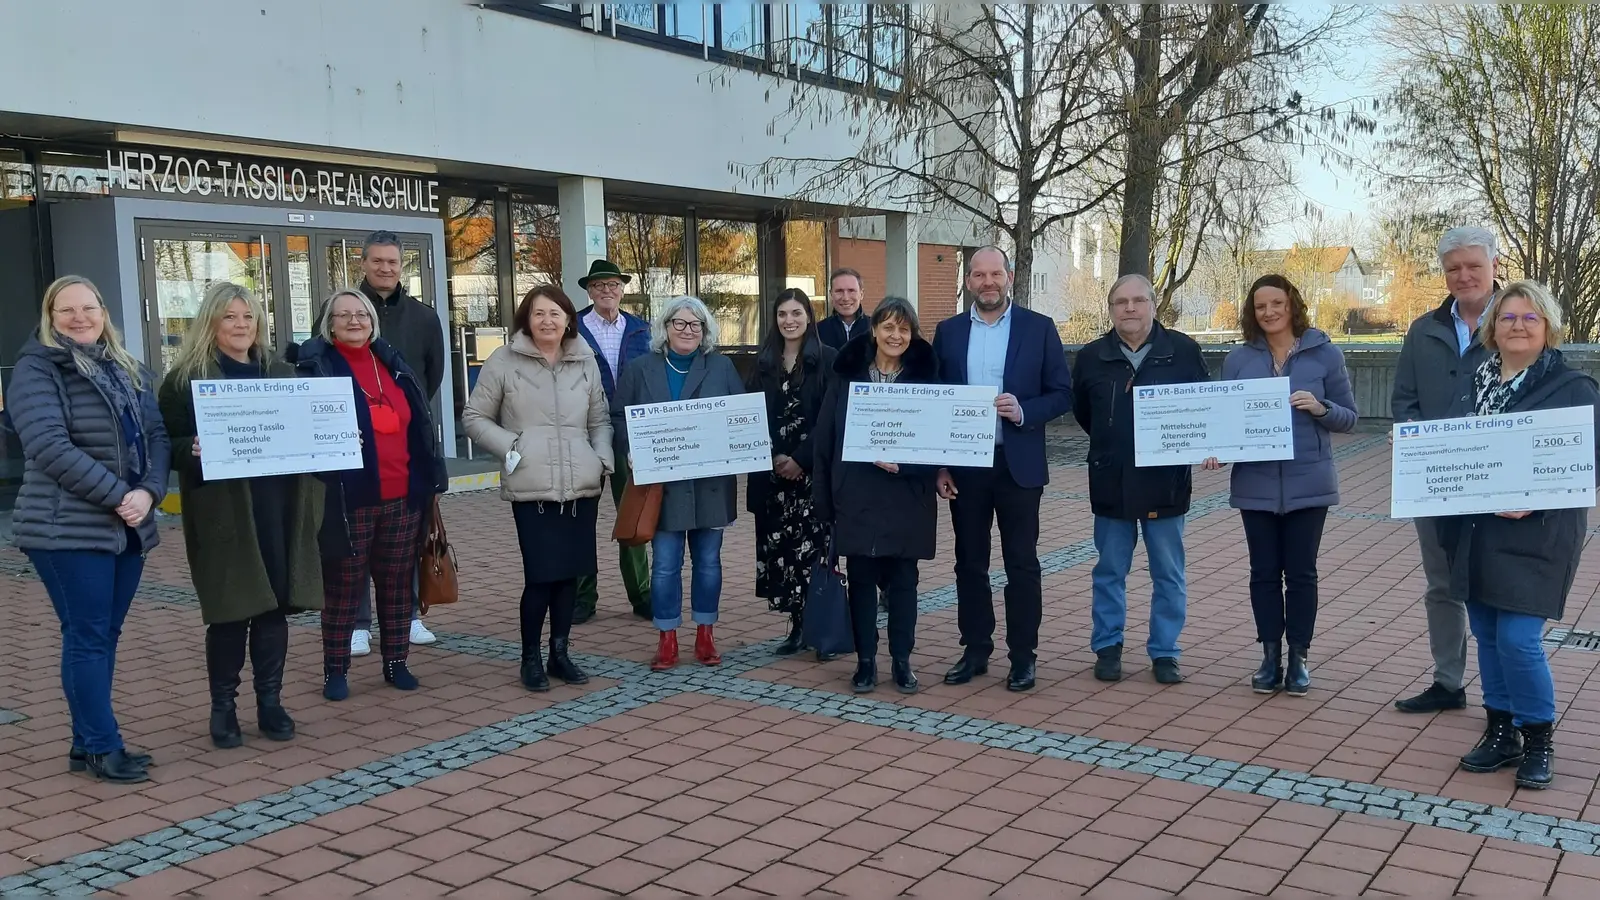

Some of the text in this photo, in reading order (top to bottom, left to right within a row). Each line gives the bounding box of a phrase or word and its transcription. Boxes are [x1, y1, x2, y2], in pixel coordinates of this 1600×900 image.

[220, 382, 310, 393] VR-Bank Erding eG
[873, 386, 955, 397] VR-Bank Erding eG
[1158, 383, 1244, 396] VR-Bank Erding eG
[648, 404, 683, 414] VR-Bank
[686, 402, 712, 411] Erding
[1160, 422, 1207, 430] Mittelschule
[1423, 415, 1533, 433] VR-Bank Erding eG
[228, 425, 256, 434] Herzog
[871, 430, 916, 438] Grundschule
[1245, 428, 1270, 436] Rotary
[229, 435, 271, 444] Realschule
[314, 433, 338, 441] Rotary
[652, 436, 685, 444] Katharina
[950, 432, 994, 440] Rotary Club
[729, 442, 751, 450] Rotary
[870, 438, 897, 446] Spende
[1162, 441, 1190, 449] Spende
[232, 447, 262, 457] Spende
[653, 445, 676, 453] Fischer
[654, 455, 680, 464] Spende
[1426, 462, 1485, 473] Mittelschule
[1533, 463, 1593, 475] Rotary Club
[1426, 473, 1489, 484] Loderer Platz
[1428, 484, 1464, 494] Spende
